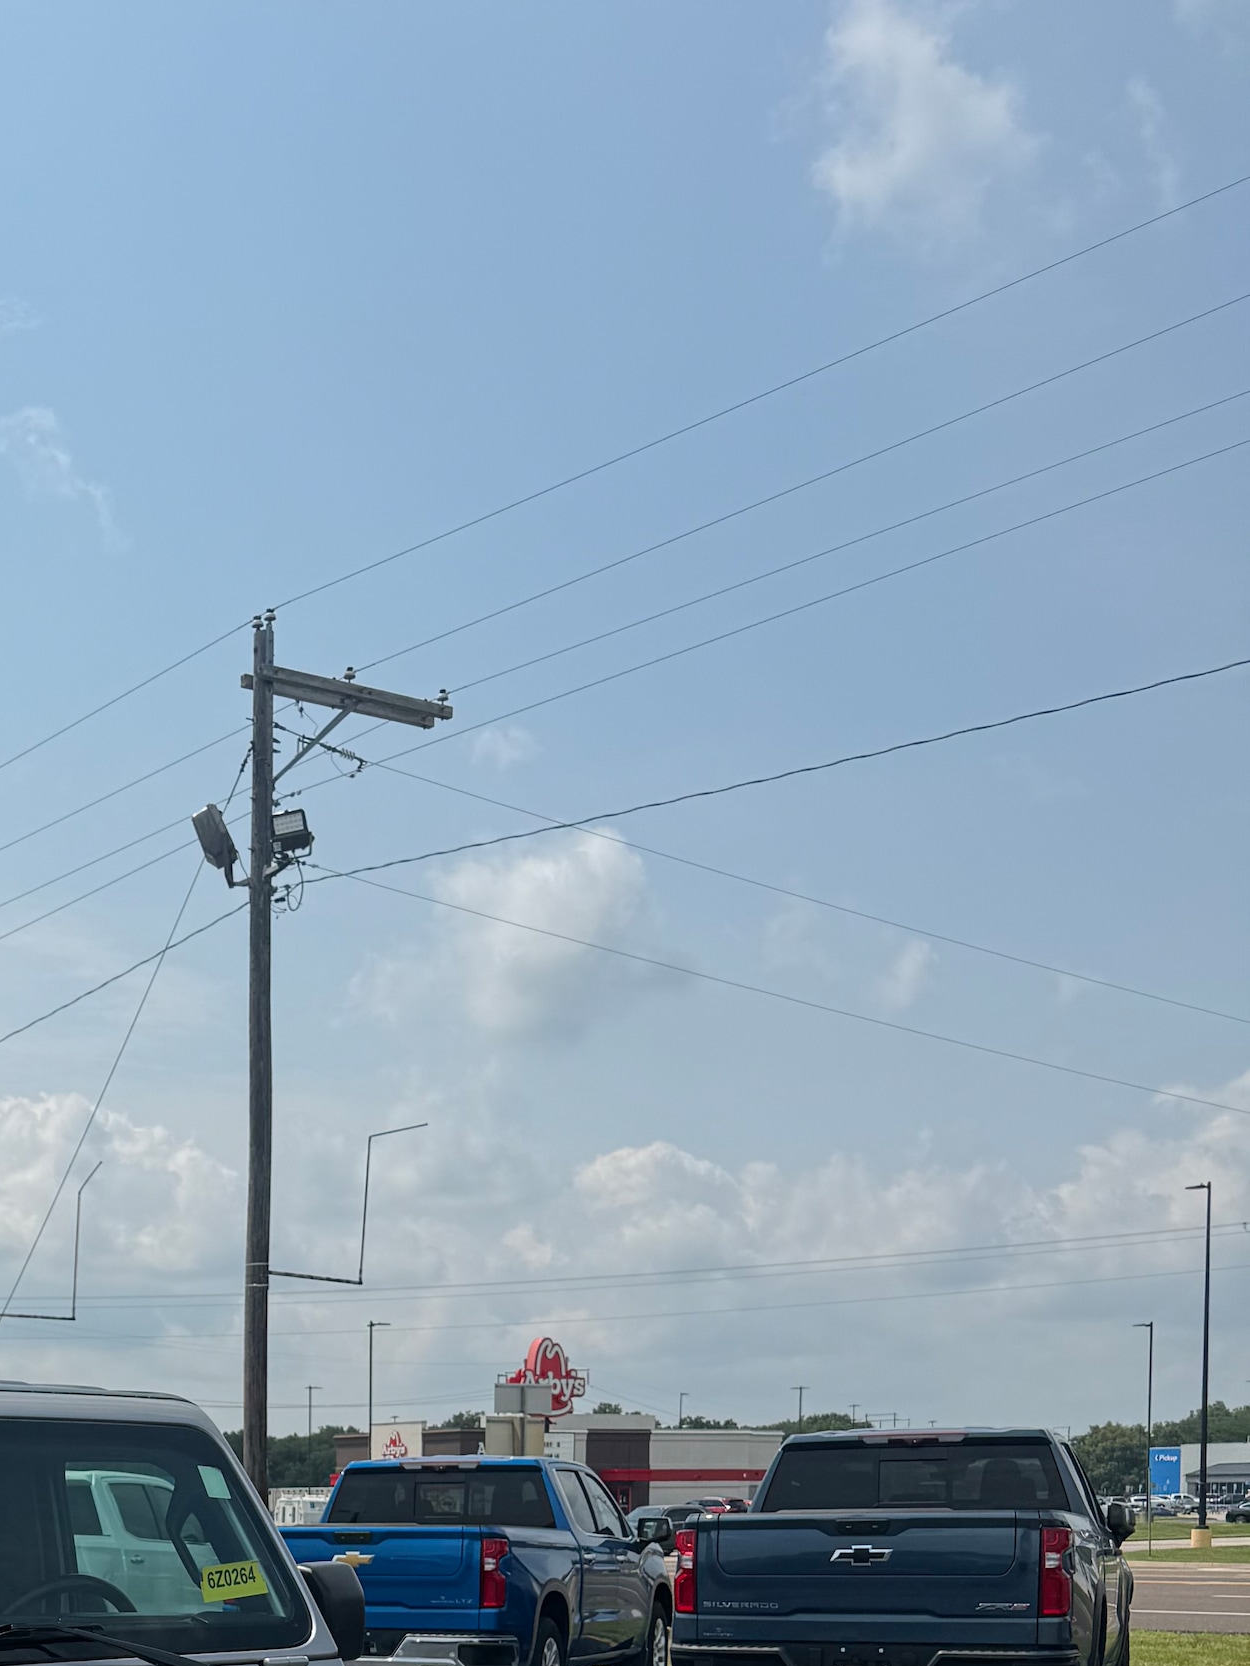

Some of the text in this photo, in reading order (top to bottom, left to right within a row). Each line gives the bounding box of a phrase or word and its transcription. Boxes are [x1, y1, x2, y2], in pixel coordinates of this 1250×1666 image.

[1159, 1454, 1177, 1462] Pickup
[207, 1565, 256, 1589] 6Z0264
[703, 1601, 779, 1609] SILVERADO
